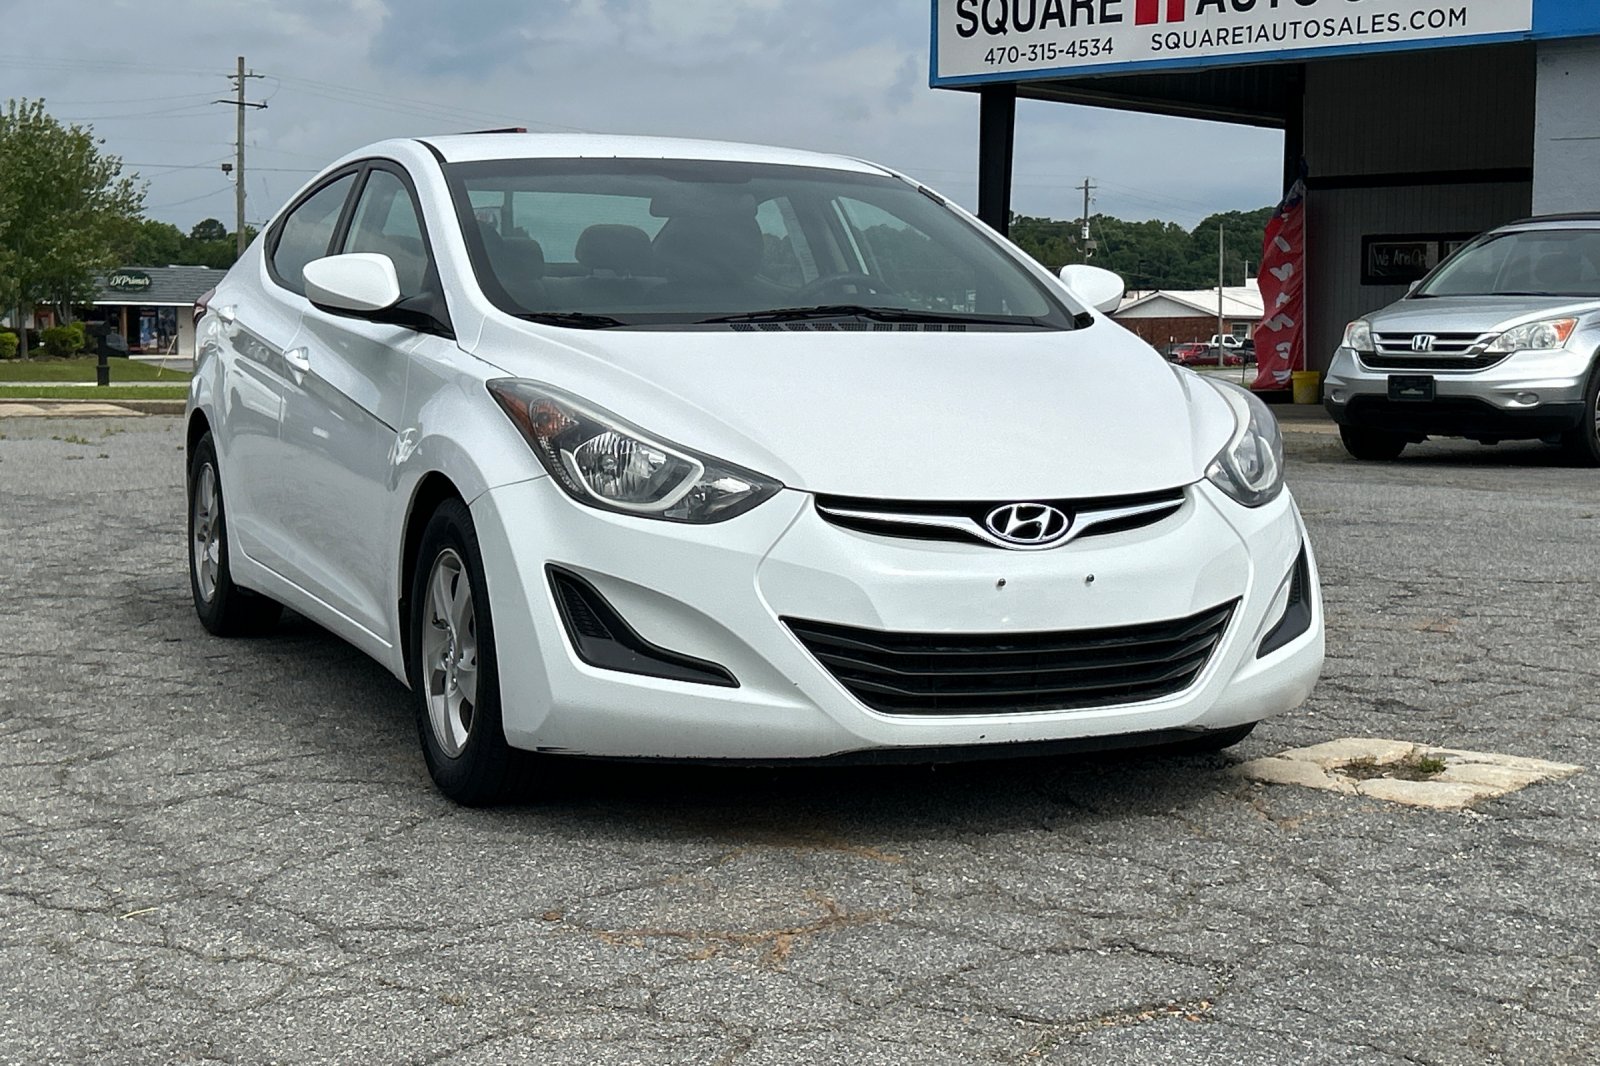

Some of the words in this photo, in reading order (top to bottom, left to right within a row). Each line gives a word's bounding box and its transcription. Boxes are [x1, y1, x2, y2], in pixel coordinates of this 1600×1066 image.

[956, 0, 1123, 38] SQUARE
[1151, 7, 1467, 51] SQUARE1AUTOSALES.COM
[984, 37, 1114, 65] 470-315-4534
